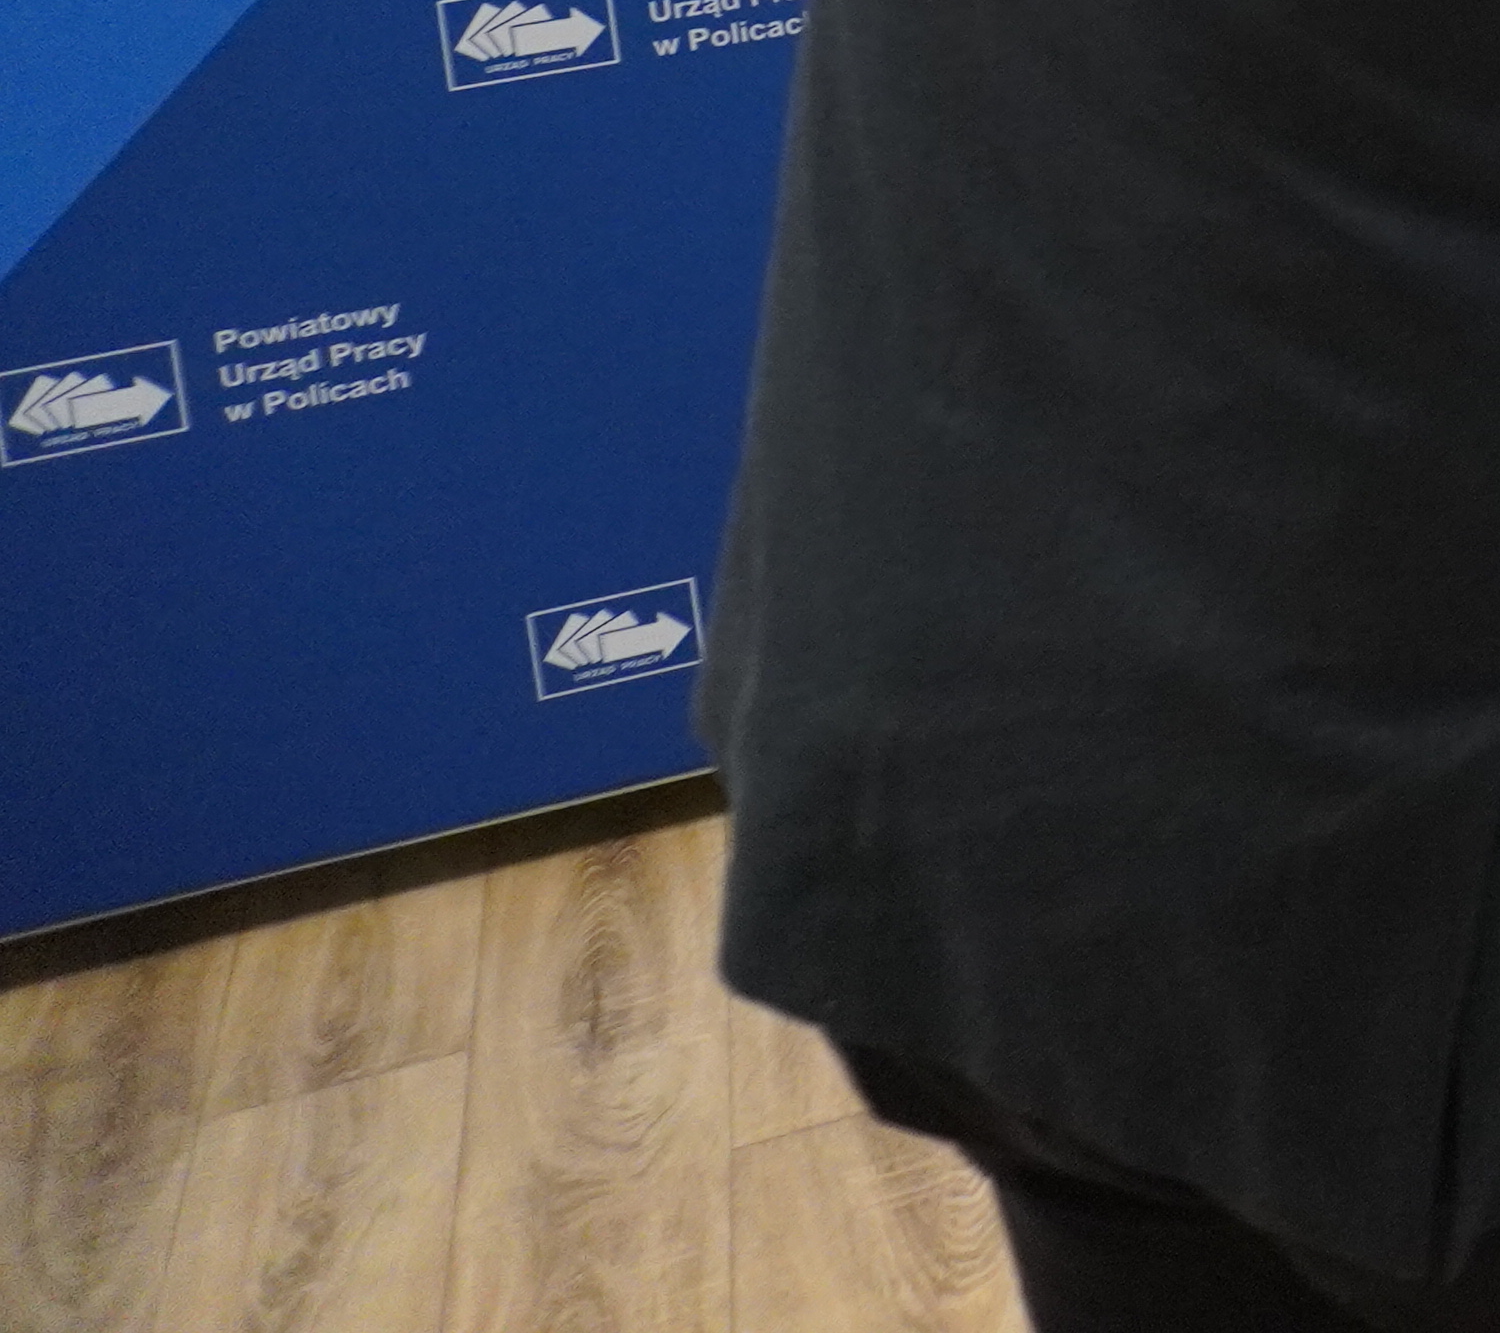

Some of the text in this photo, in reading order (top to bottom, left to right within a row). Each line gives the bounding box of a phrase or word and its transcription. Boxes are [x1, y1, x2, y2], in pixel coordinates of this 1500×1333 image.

[652, 37, 680, 57] w
[213, 303, 400, 354] Powiatowy
[219, 333, 427, 388] Urząd Pracy
[223, 368, 412, 423] w Policach
